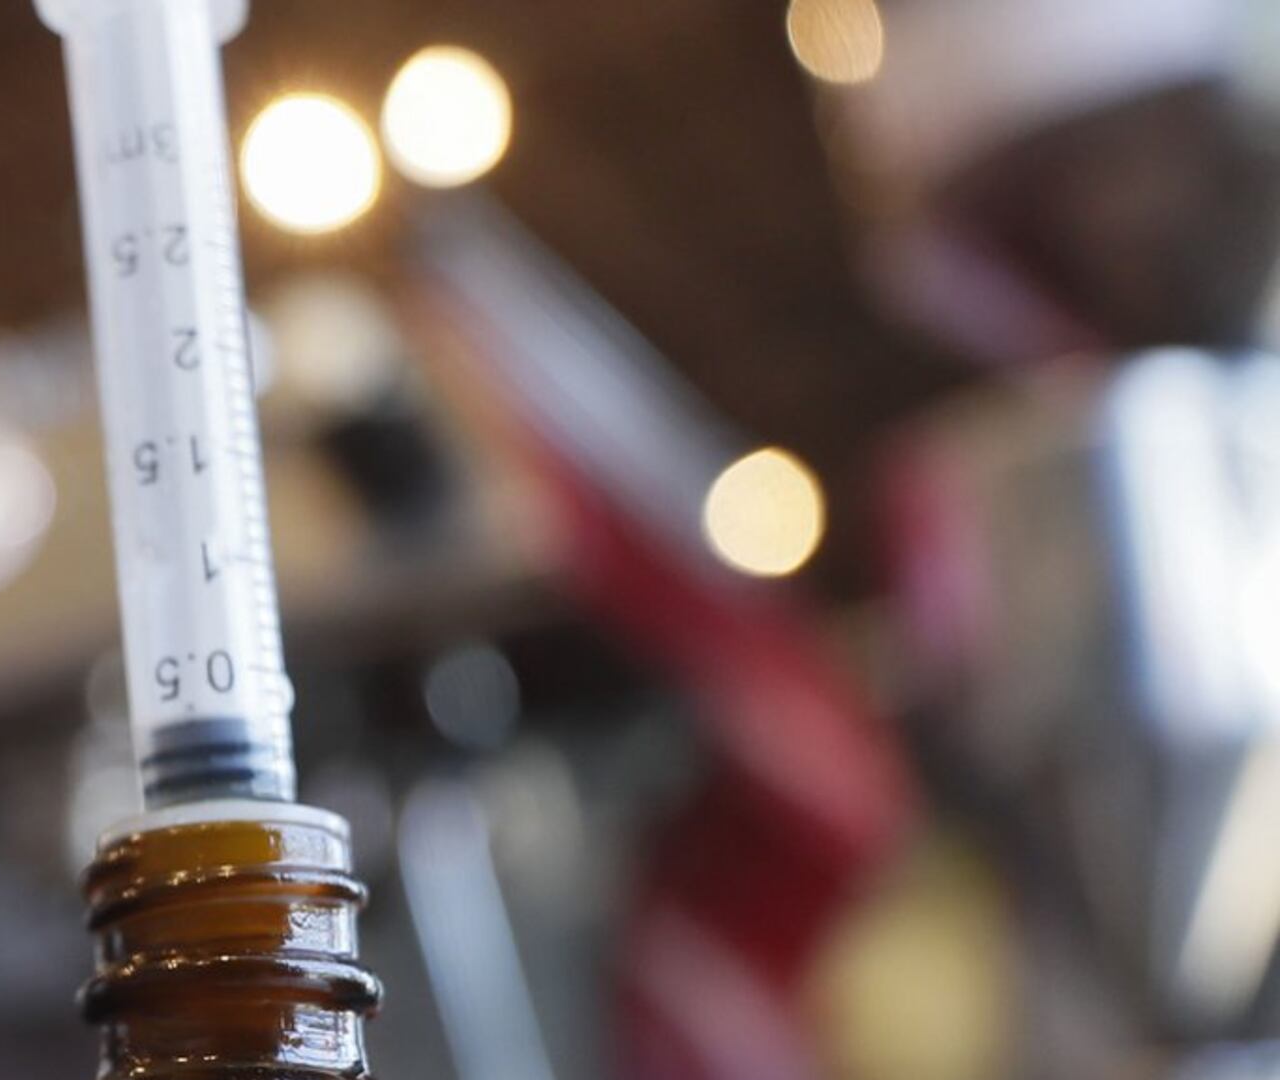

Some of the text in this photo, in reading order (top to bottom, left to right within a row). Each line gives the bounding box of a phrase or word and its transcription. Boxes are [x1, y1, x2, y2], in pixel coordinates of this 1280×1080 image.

[111, 223, 190, 278] 2.5
[170, 326, 201, 371] 2
[133, 434, 208, 484] 1.5
[200, 541, 220, 583] 1
[155, 650, 235, 701] 0.5
